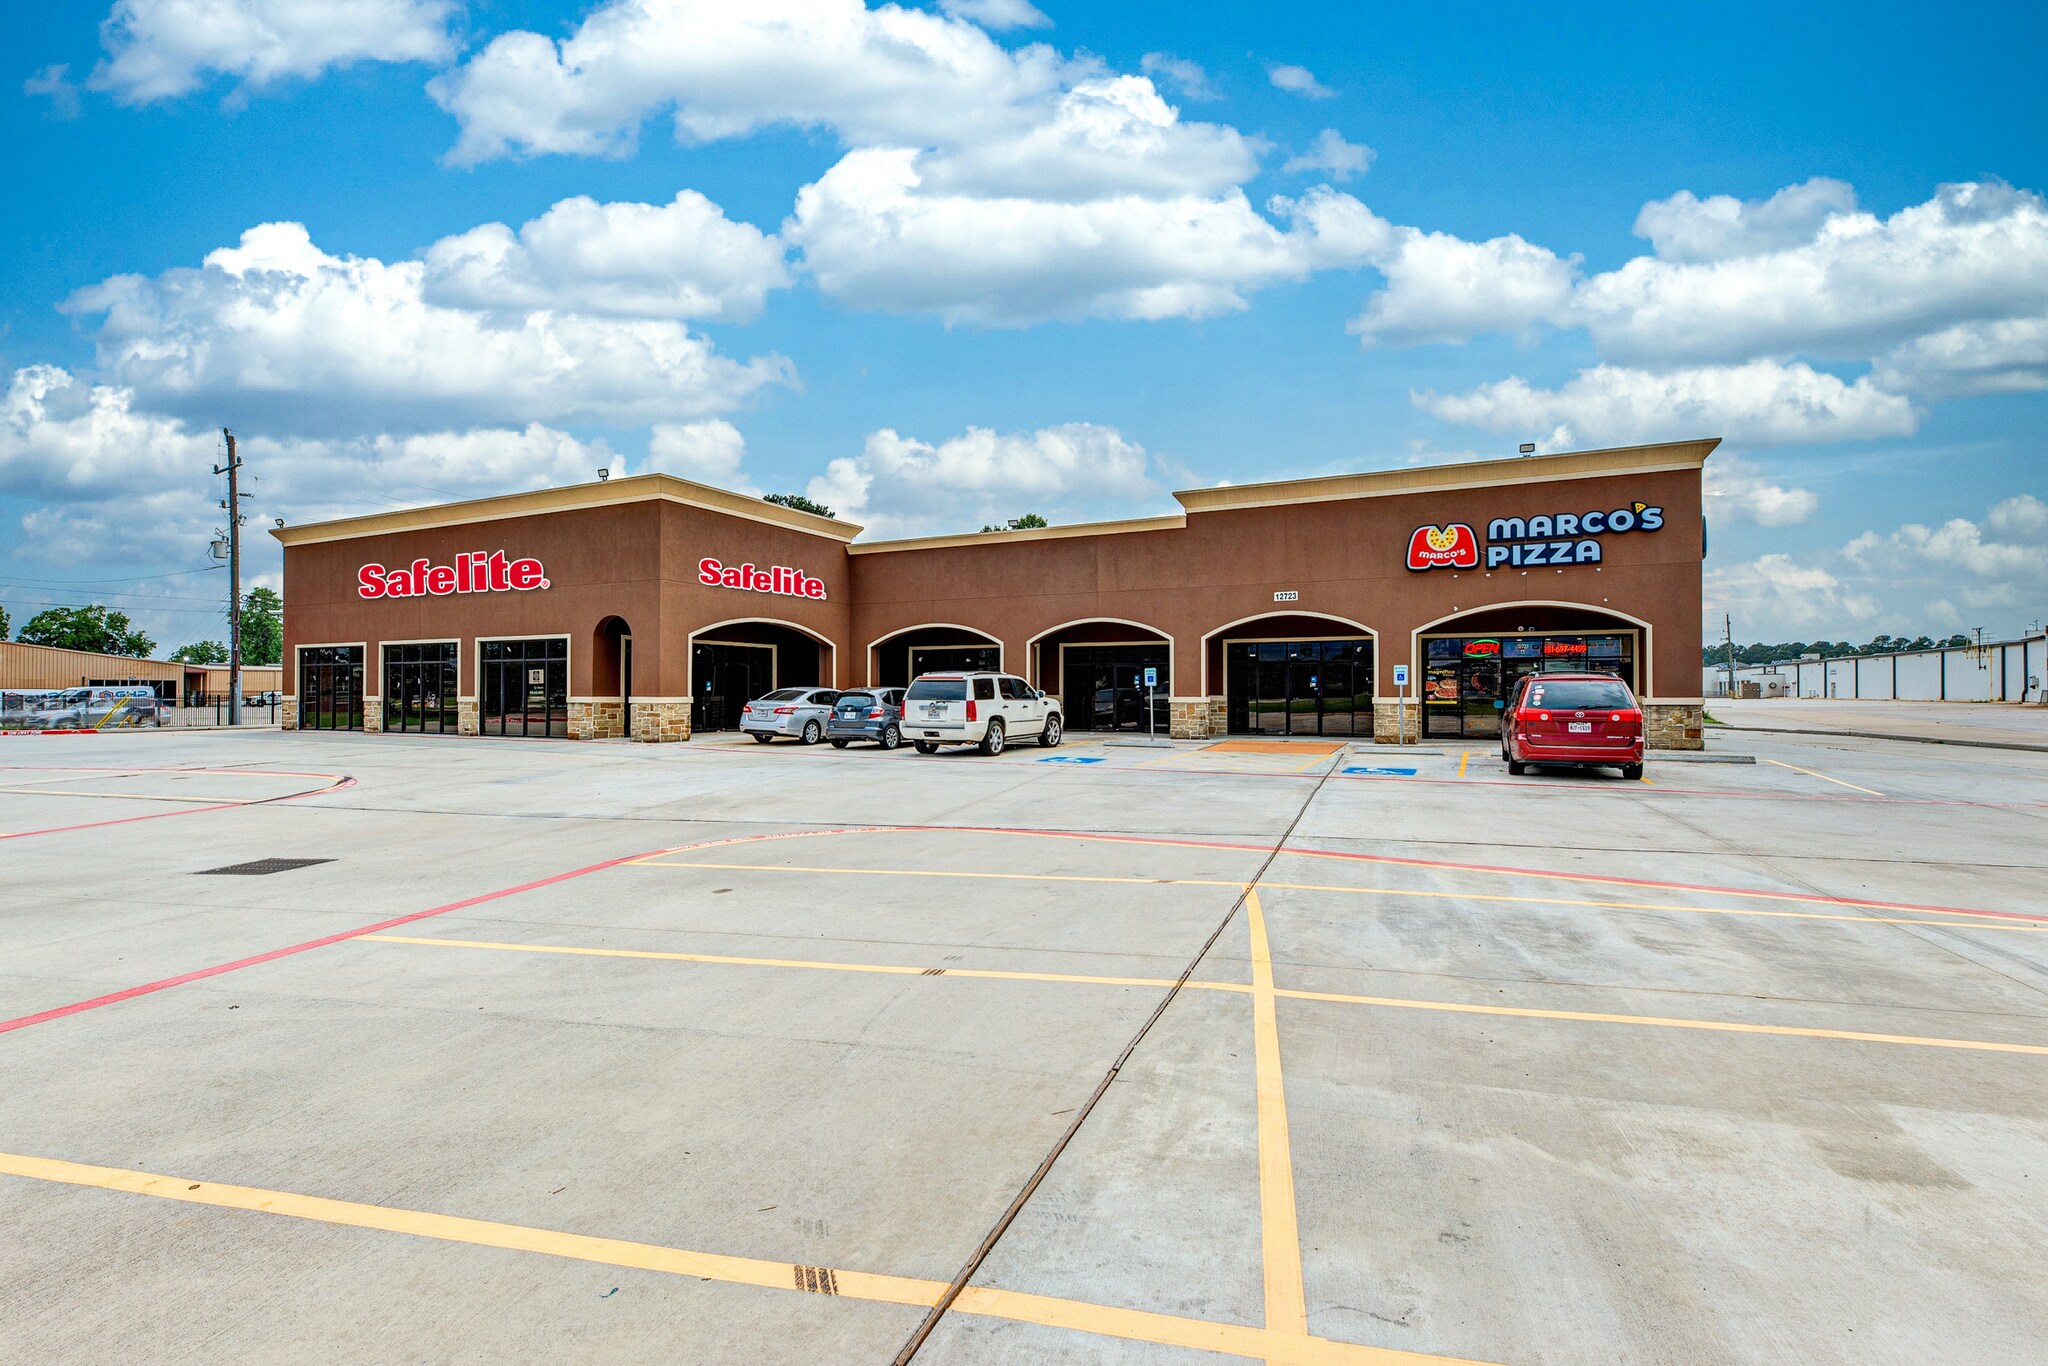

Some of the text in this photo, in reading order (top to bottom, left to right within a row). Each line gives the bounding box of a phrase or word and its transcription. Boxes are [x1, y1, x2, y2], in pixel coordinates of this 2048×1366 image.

[1487, 502, 1664, 540] MARCO'S
[1418, 548, 1467, 560] MARCO'S
[1487, 539, 1602, 567] PIZZA
[358, 550, 544, 599] Safelite
[699, 558, 825, 599] Safelite
[1275, 592, 1297, 600] 12723
[1463, 643, 1500, 654] OPEN
